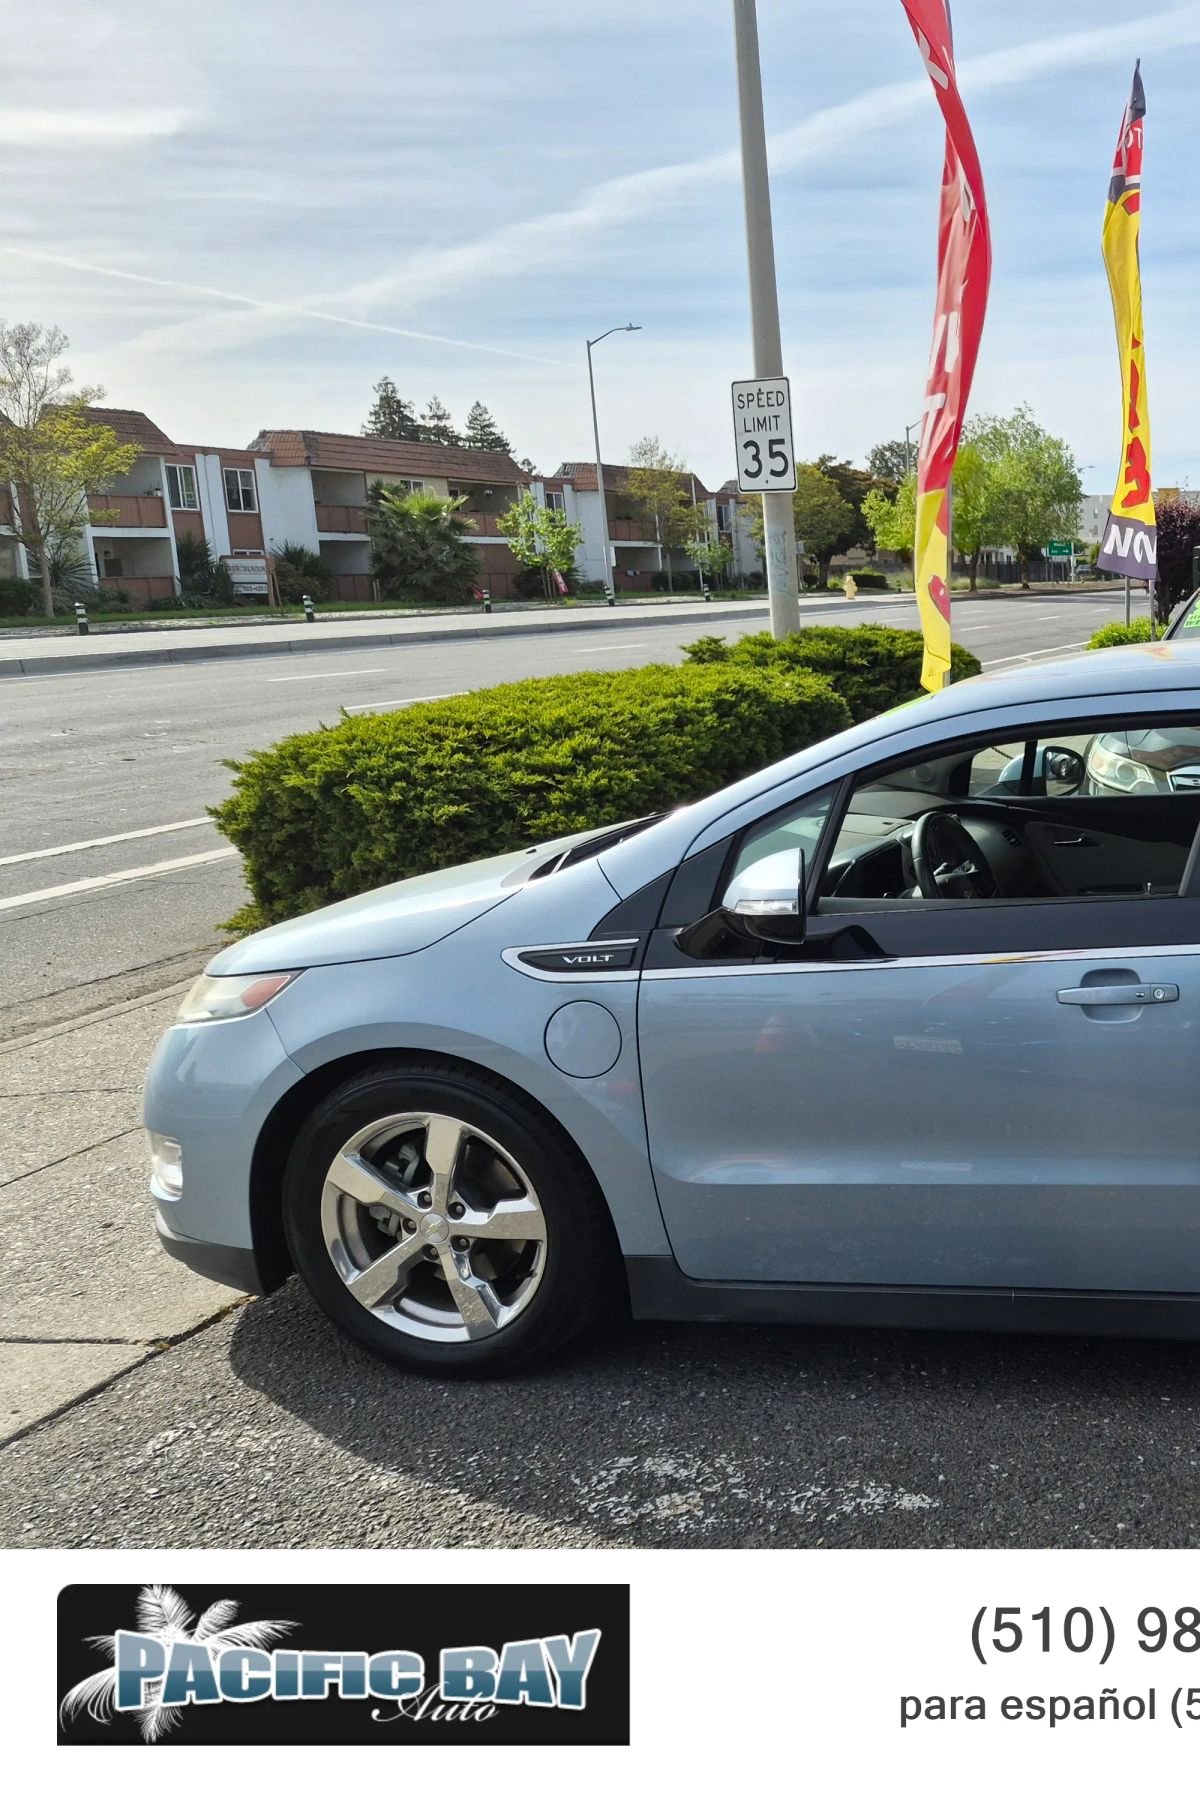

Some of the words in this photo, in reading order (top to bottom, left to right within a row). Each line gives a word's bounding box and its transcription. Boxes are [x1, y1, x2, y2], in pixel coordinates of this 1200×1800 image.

[737, 390, 785, 409] SPEED
[743, 415, 781, 433] LIMIT
[742, 438, 789, 479] 35
[562, 954, 615, 964] VOLT
